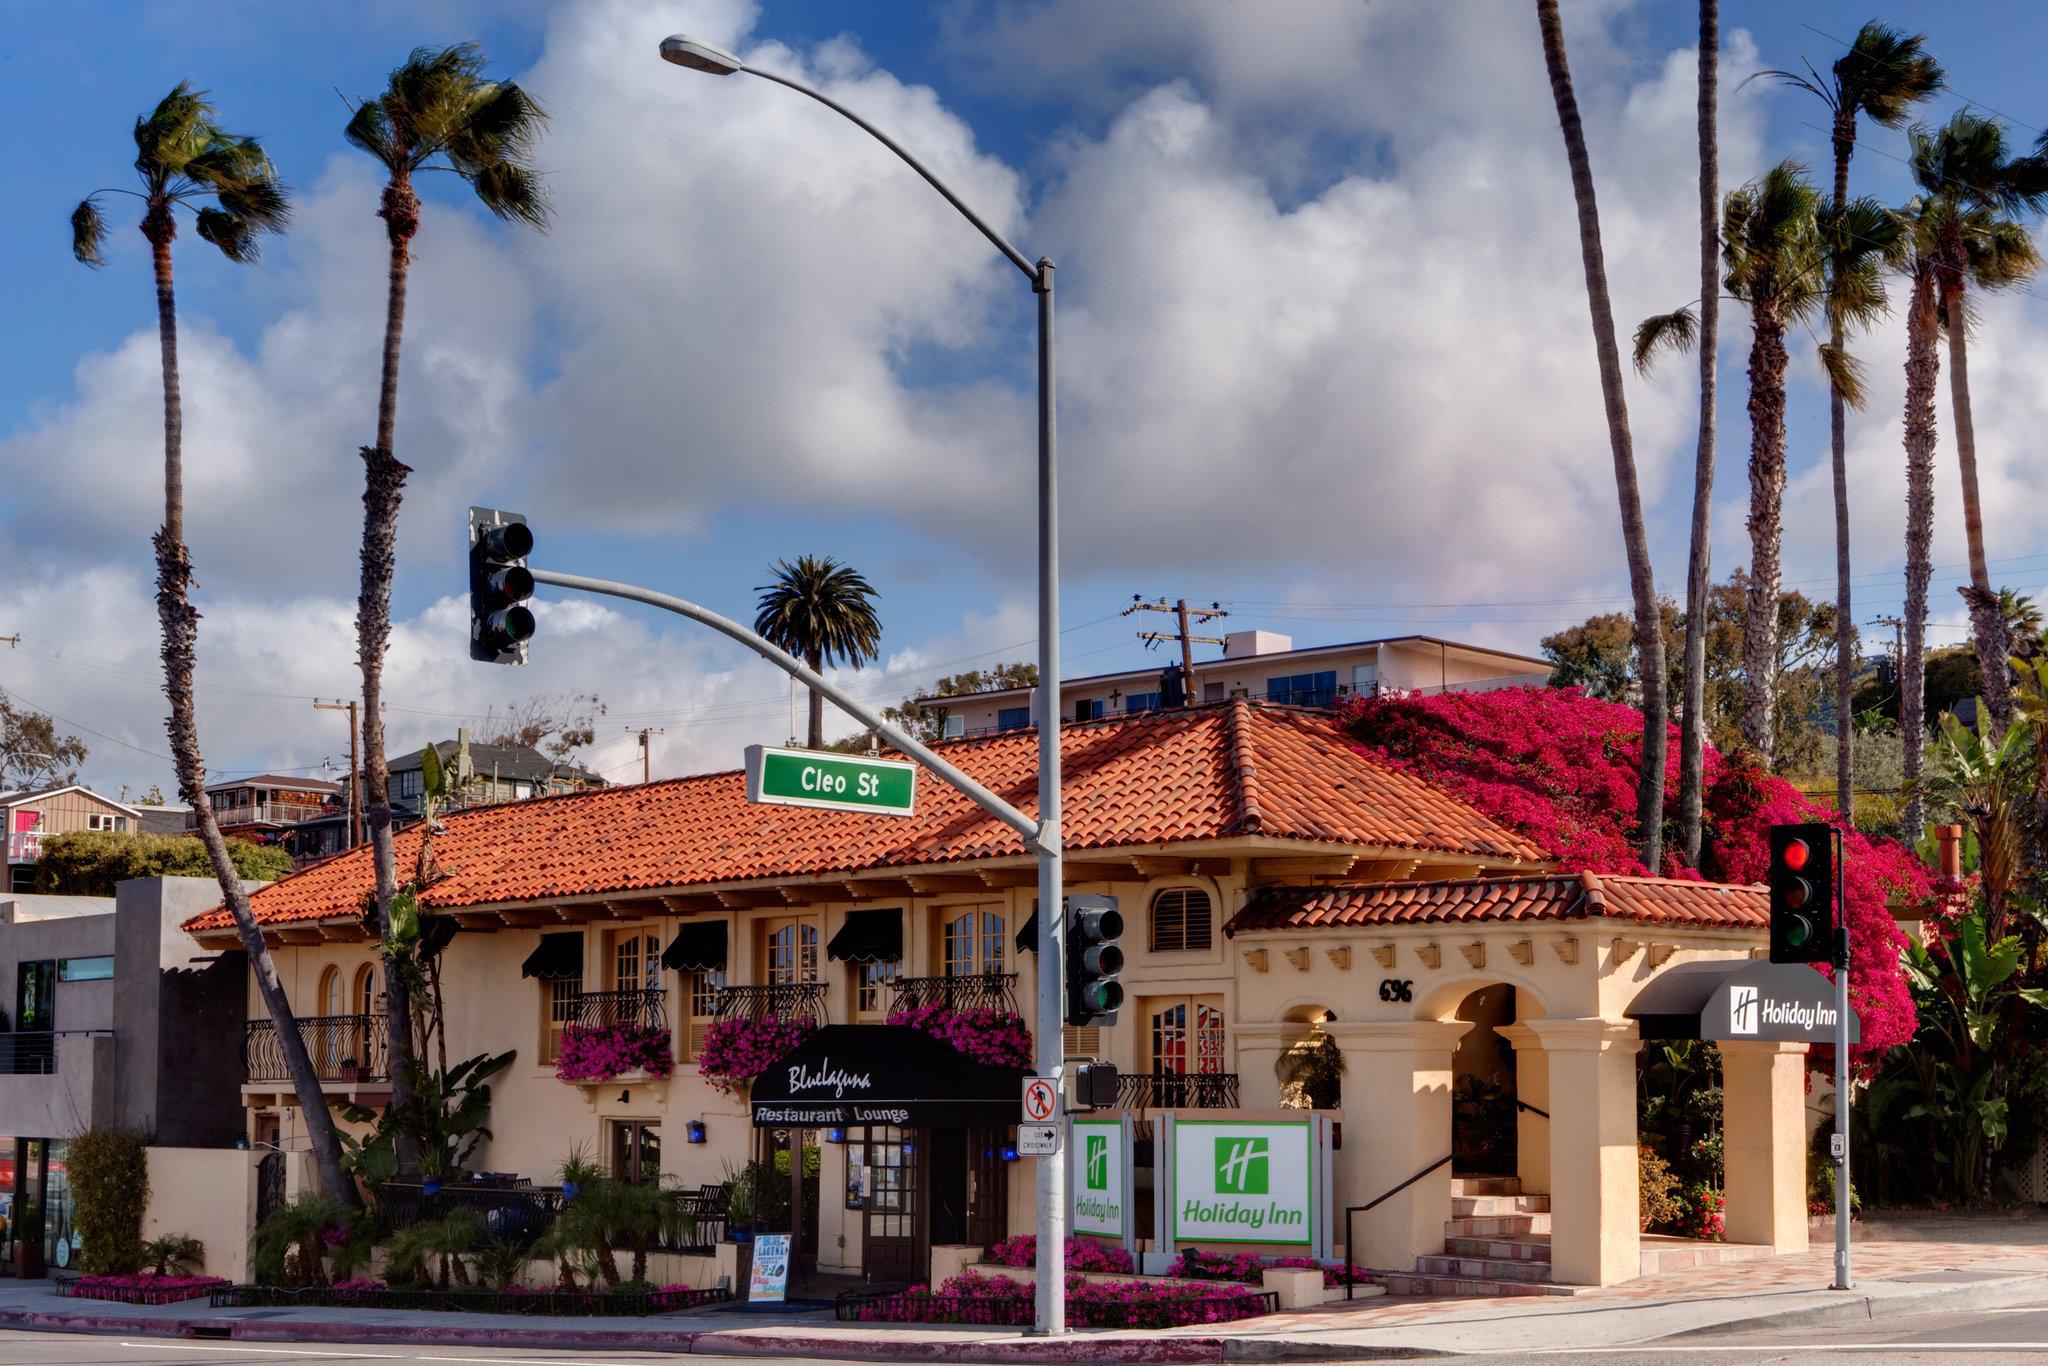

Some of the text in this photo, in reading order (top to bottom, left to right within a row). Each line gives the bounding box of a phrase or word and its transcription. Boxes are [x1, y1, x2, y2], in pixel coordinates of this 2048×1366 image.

[801, 766, 879, 797] Cleo St
[1379, 979, 1413, 1002] 696
[1762, 999, 1837, 1030] Holiday Inn
[755, 1106, 909, 1123] Restaurant Lounge
[1076, 1195, 1120, 1222] Holiday Inn
[1183, 1200, 1303, 1229] Holiday Inn
